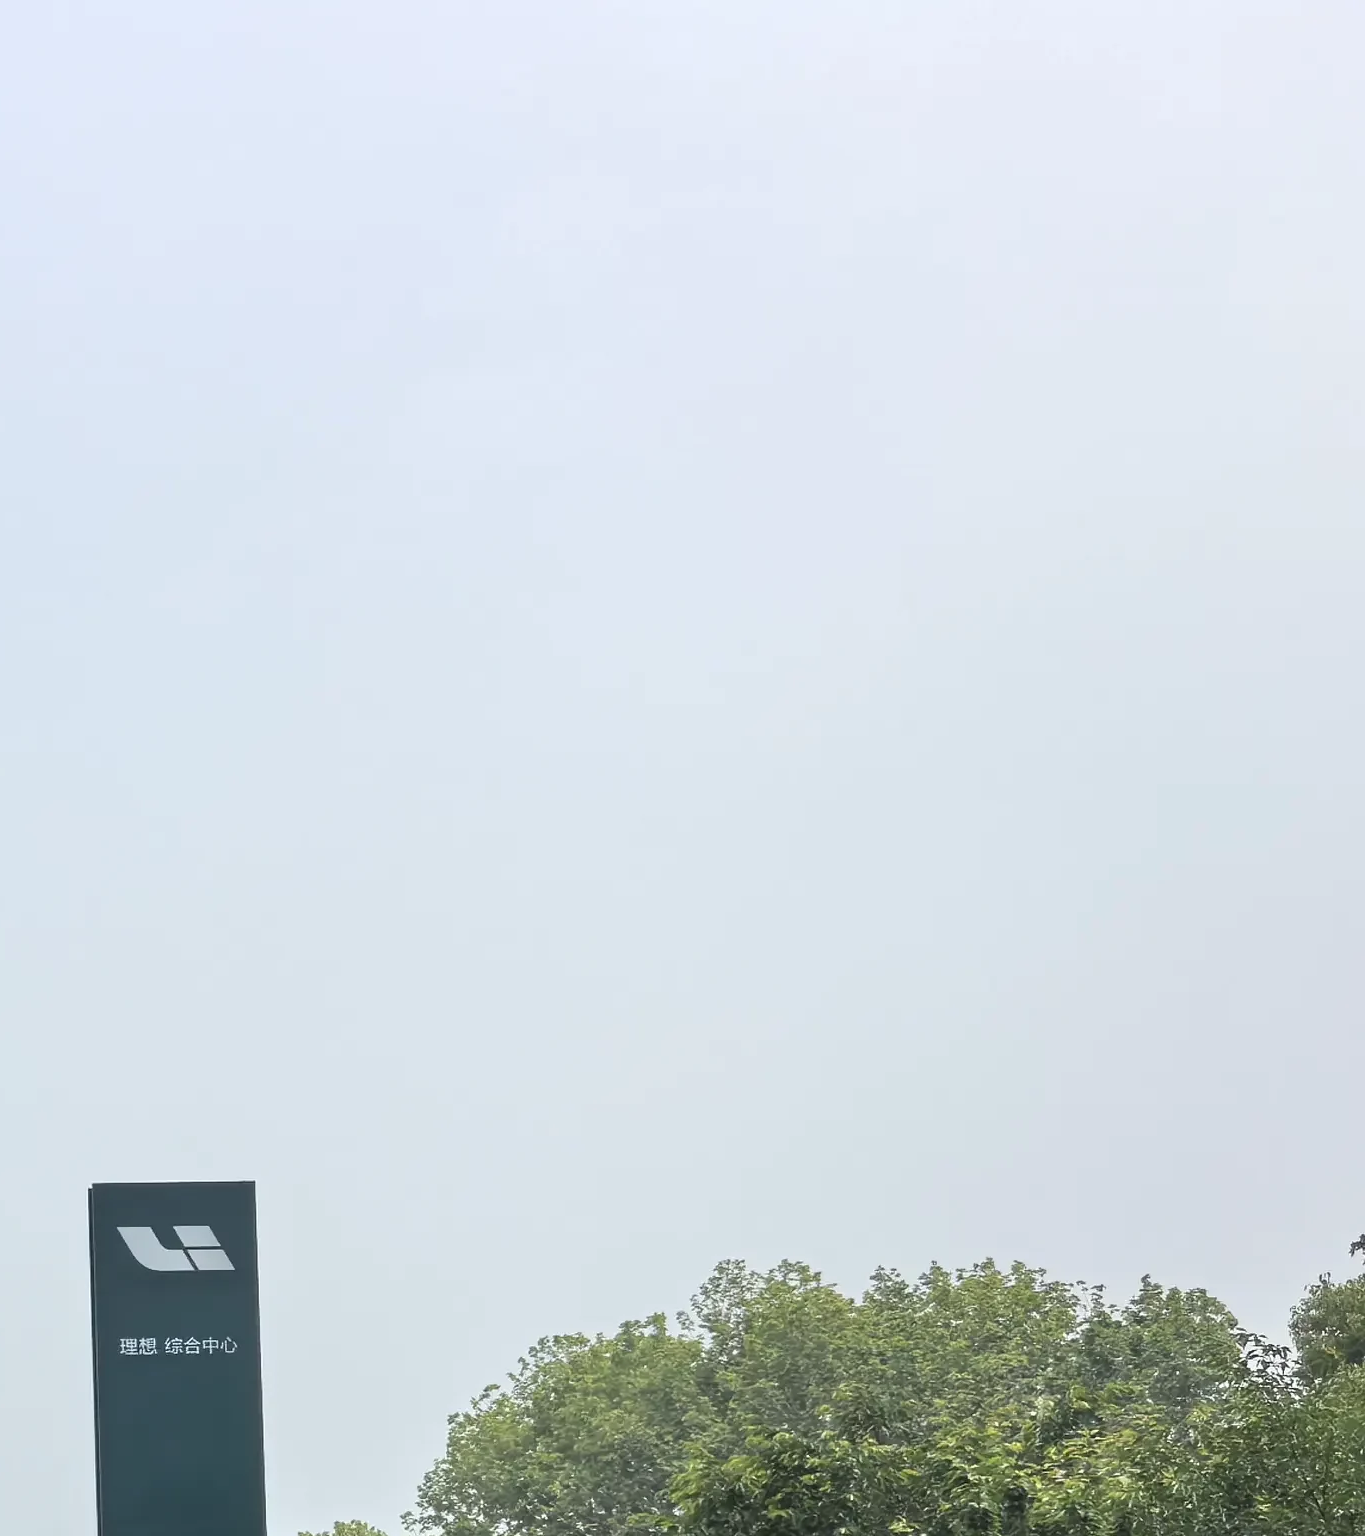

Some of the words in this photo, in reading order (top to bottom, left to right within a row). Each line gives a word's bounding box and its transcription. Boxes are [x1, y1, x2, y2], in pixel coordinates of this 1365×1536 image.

[119, 1337, 158, 1355] 理想
[164, 1336, 238, 1355] 综合中心
